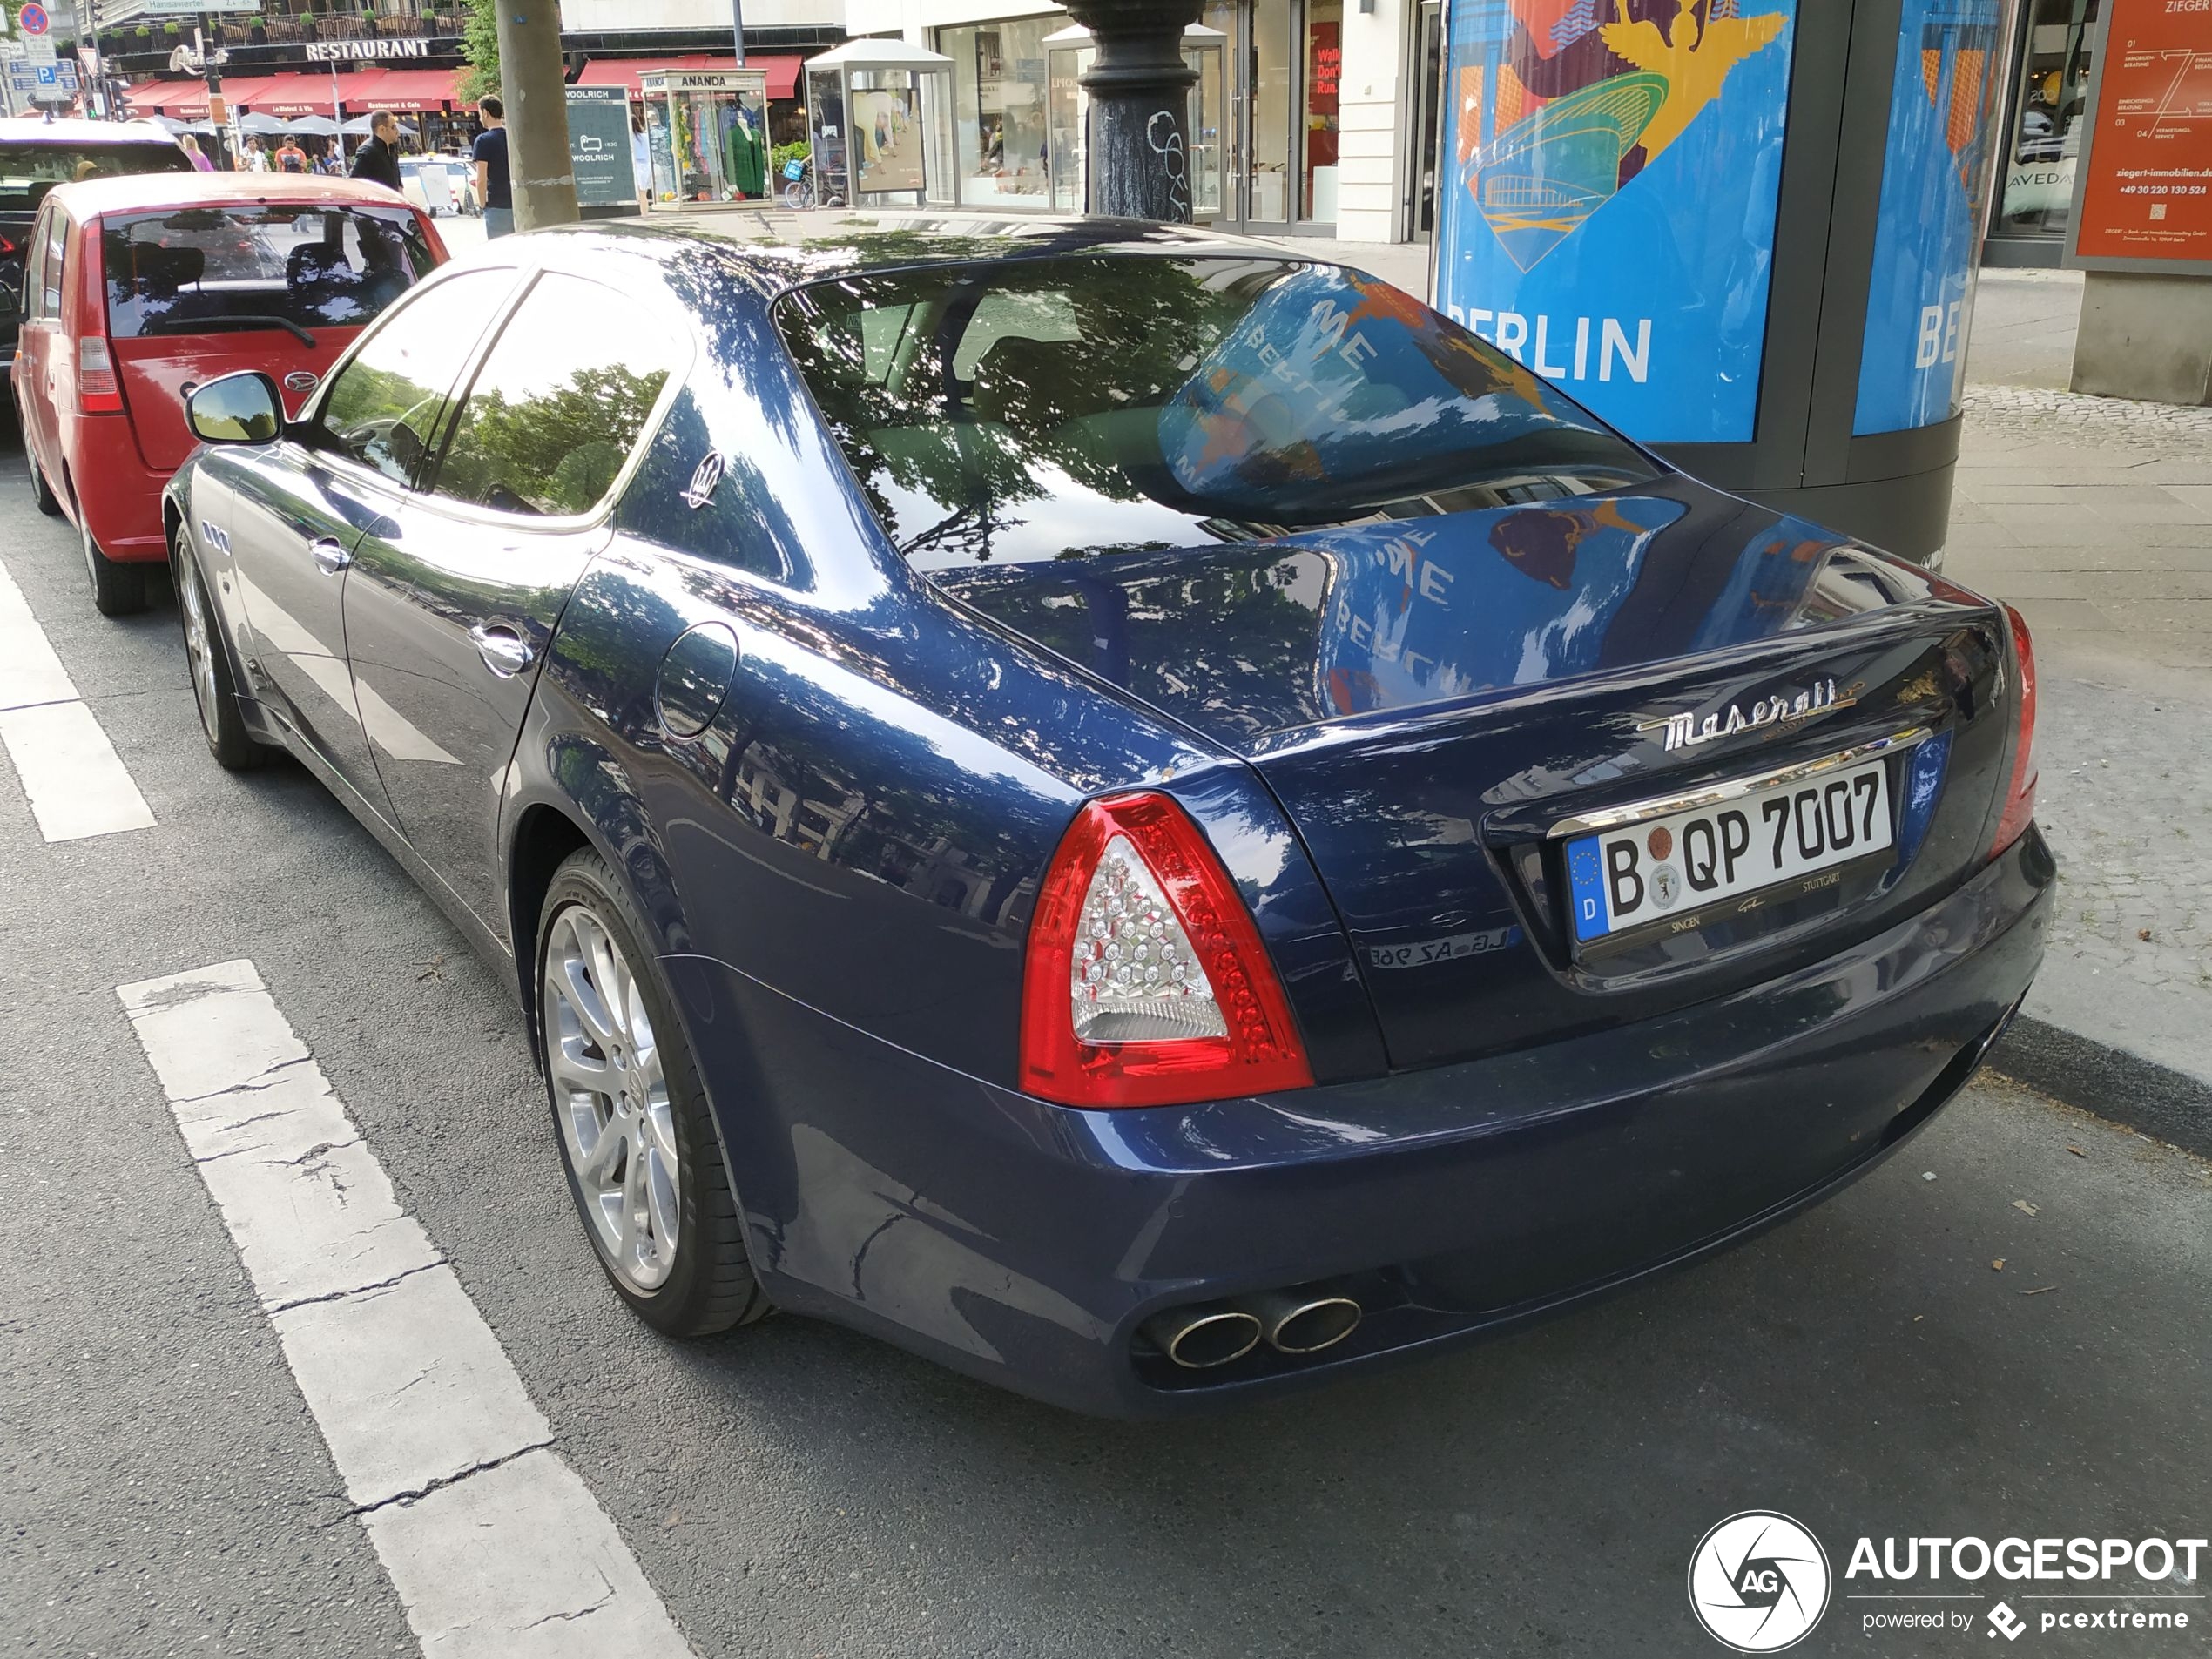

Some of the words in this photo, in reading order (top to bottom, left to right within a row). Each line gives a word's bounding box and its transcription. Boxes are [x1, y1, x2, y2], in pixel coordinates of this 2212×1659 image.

[2165, 0, 2212, 13] ZIEGER
[306, 39, 429, 62] RESTAURANT
[682, 76, 726, 86] ANANDA
[1318, 80, 1338, 94] Run.
[2008, 173, 2072, 188] AVEDA
[2116, 168, 2212, 179] ziegert-immobilien.de
[2120, 185, 2136, 194] +49
[2137, 185, 2149, 194] 30
[2150, 185, 2168, 194] 220
[2171, 185, 2187, 194] 130
[2188, 185, 2207, 194] 524
[1637, 678, 1857, 752] Maserati
[1607, 839, 1644, 917] B
[1683, 809, 1750, 892] QP
[1762, 772, 1879, 870] 7007
[1802, 872, 1840, 893] STUTTGART
[1584, 898, 1595, 921] D
[1671, 916, 1701, 934] SINGEN
